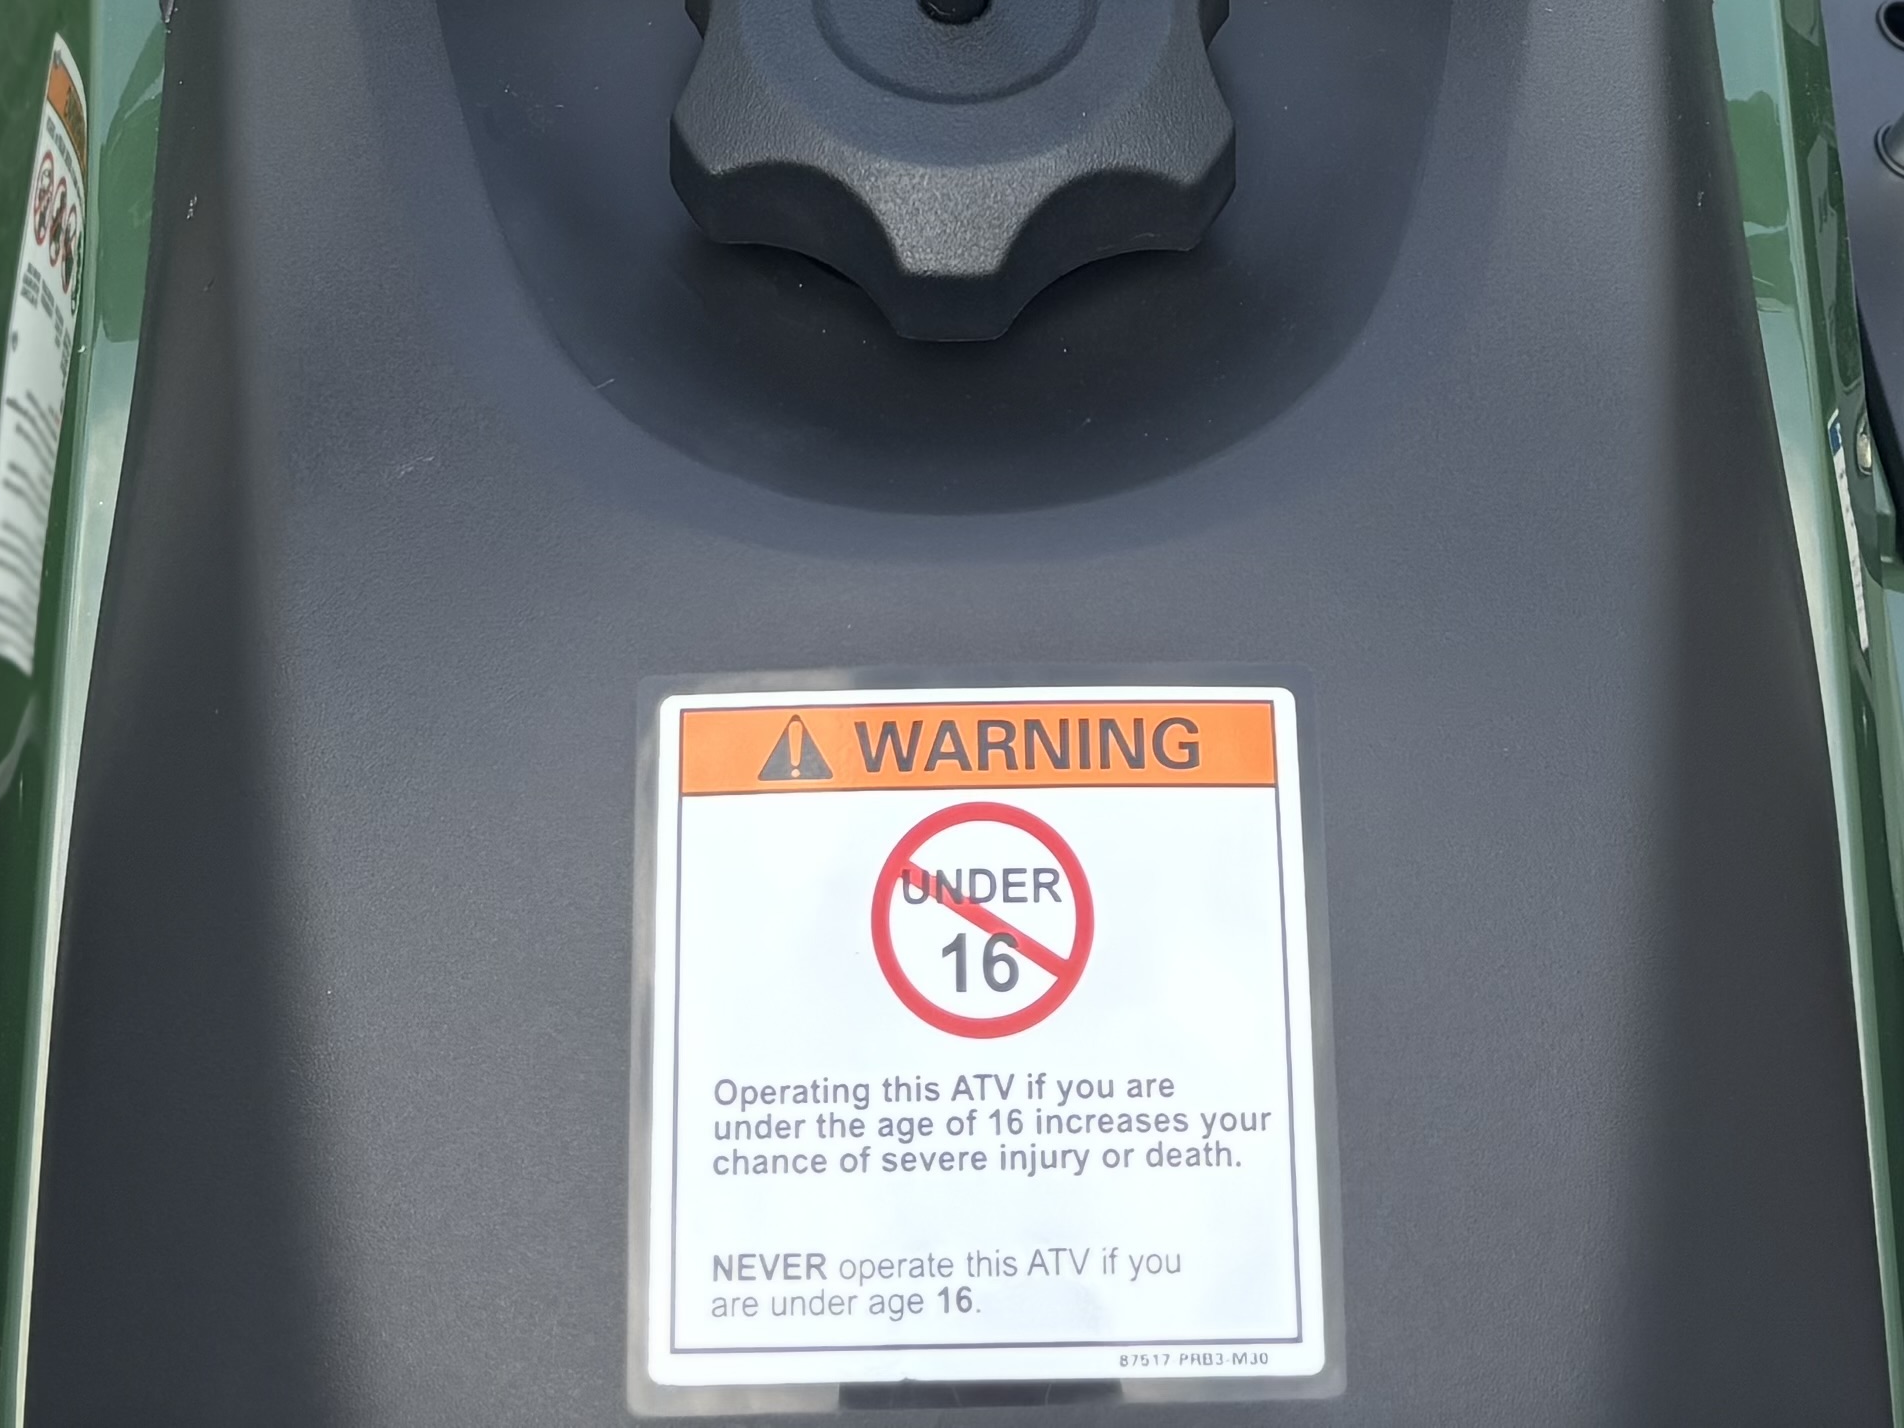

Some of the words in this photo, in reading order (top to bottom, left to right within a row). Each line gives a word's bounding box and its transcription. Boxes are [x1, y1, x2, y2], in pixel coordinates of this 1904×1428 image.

[855, 717, 1199, 773] WARNING
[900, 867, 1062, 905] UNDER
[941, 932, 1021, 994] 16
[715, 1077, 869, 1112] Operating
[882, 1075, 940, 1103] this
[951, 1073, 1014, 1102] ATV
[1028, 1072, 1046, 1100] if
[1057, 1078, 1113, 1107] you
[1127, 1078, 1174, 1098] are
[715, 1109, 806, 1140] under
[816, 1107, 867, 1139] the
[878, 1117, 933, 1144] age
[946, 1108, 977, 1136] of
[989, 1109, 1023, 1136] 16
[1037, 1105, 1188, 1134] increases
[1201, 1112, 1271, 1139] your
[713, 1149, 827, 1176] chance
[840, 1145, 871, 1173] of
[882, 1150, 987, 1173] severe
[1001, 1143, 1089, 1177] injury
[1102, 1148, 1134, 1168] or
[1146, 1140, 1241, 1168] death.
[713, 1253, 827, 1282] NEVER
[840, 1252, 953, 1287] operate
[967, 1249, 1017, 1277] this
[1027, 1247, 1089, 1277] ATV
[1103, 1246, 1118, 1274] if
[1129, 1253, 1180, 1282] you
[712, 1296, 758, 1318] are
[772, 1285, 857, 1317] under
[868, 1292, 925, 1322] age
[938, 1286, 981, 1314] 16.
